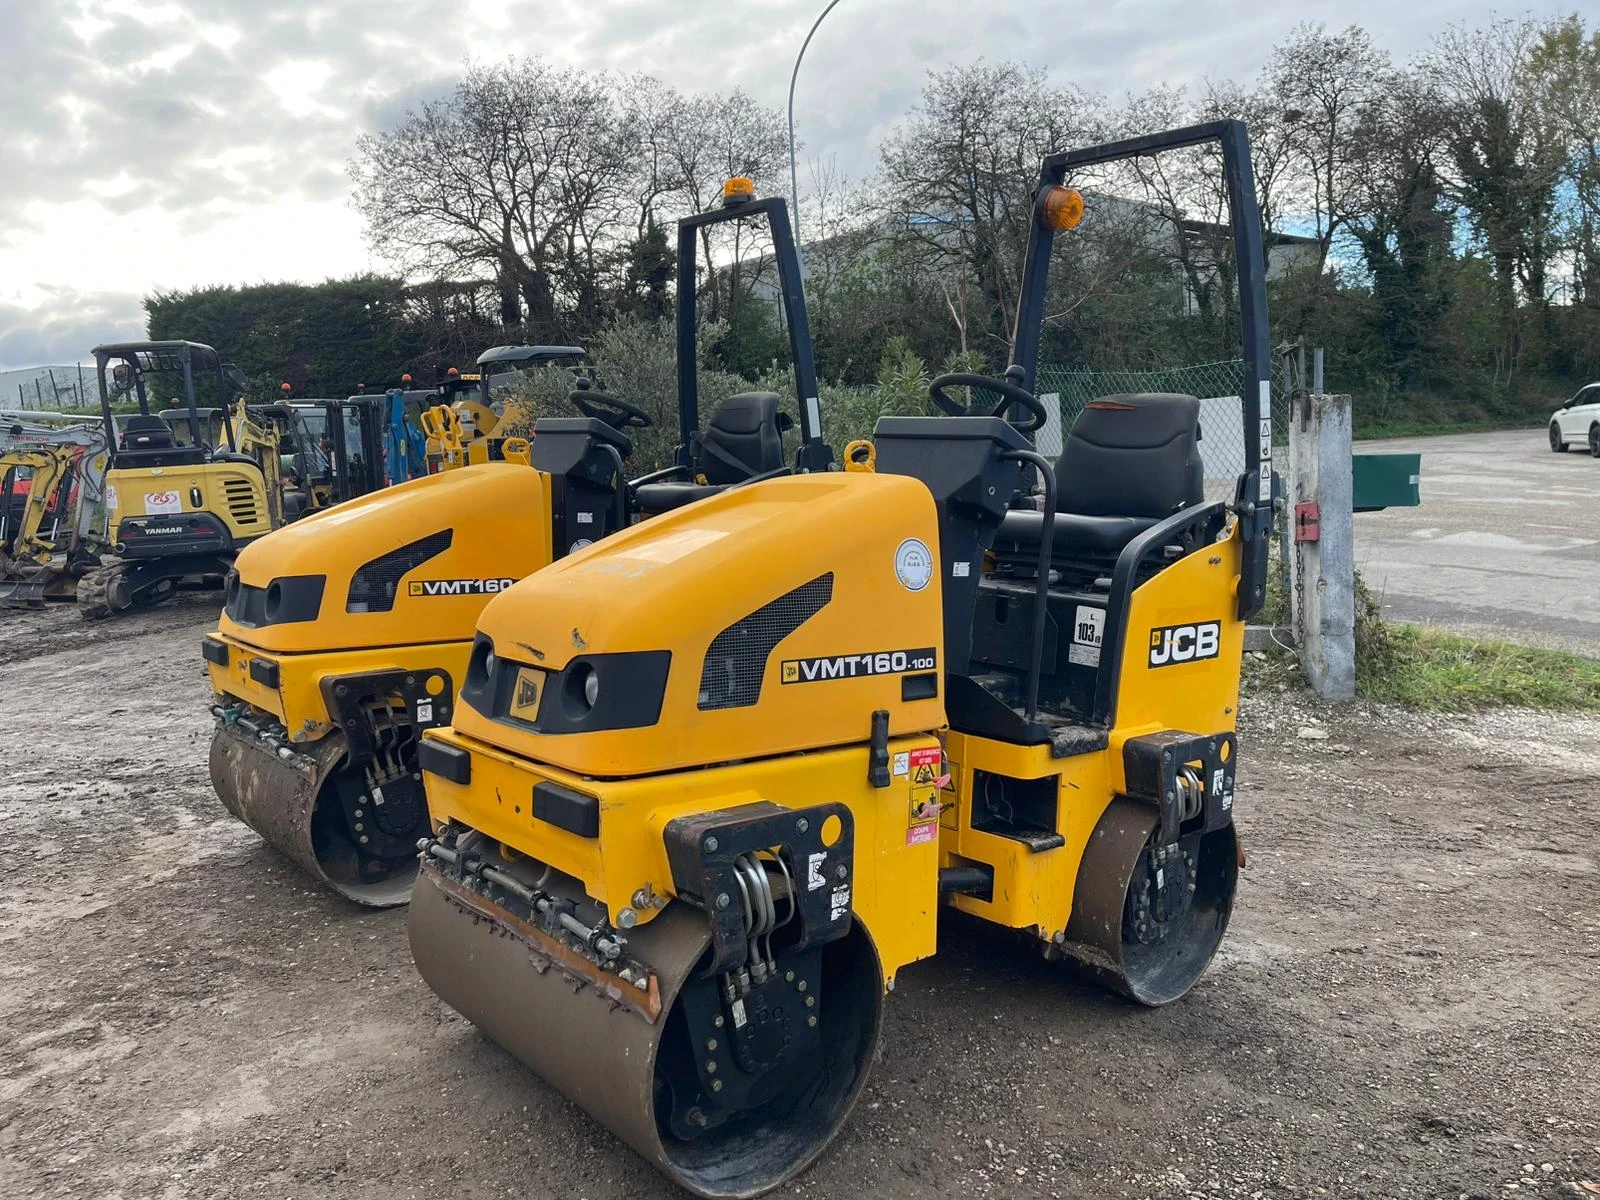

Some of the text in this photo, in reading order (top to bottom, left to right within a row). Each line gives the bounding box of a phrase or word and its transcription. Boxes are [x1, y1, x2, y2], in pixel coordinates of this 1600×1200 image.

[145, 527, 182, 535] YANMAR
[424, 579, 513, 595] VMT160
[1078, 622, 1095, 642] 103
[1151, 623, 1219, 664] JCB
